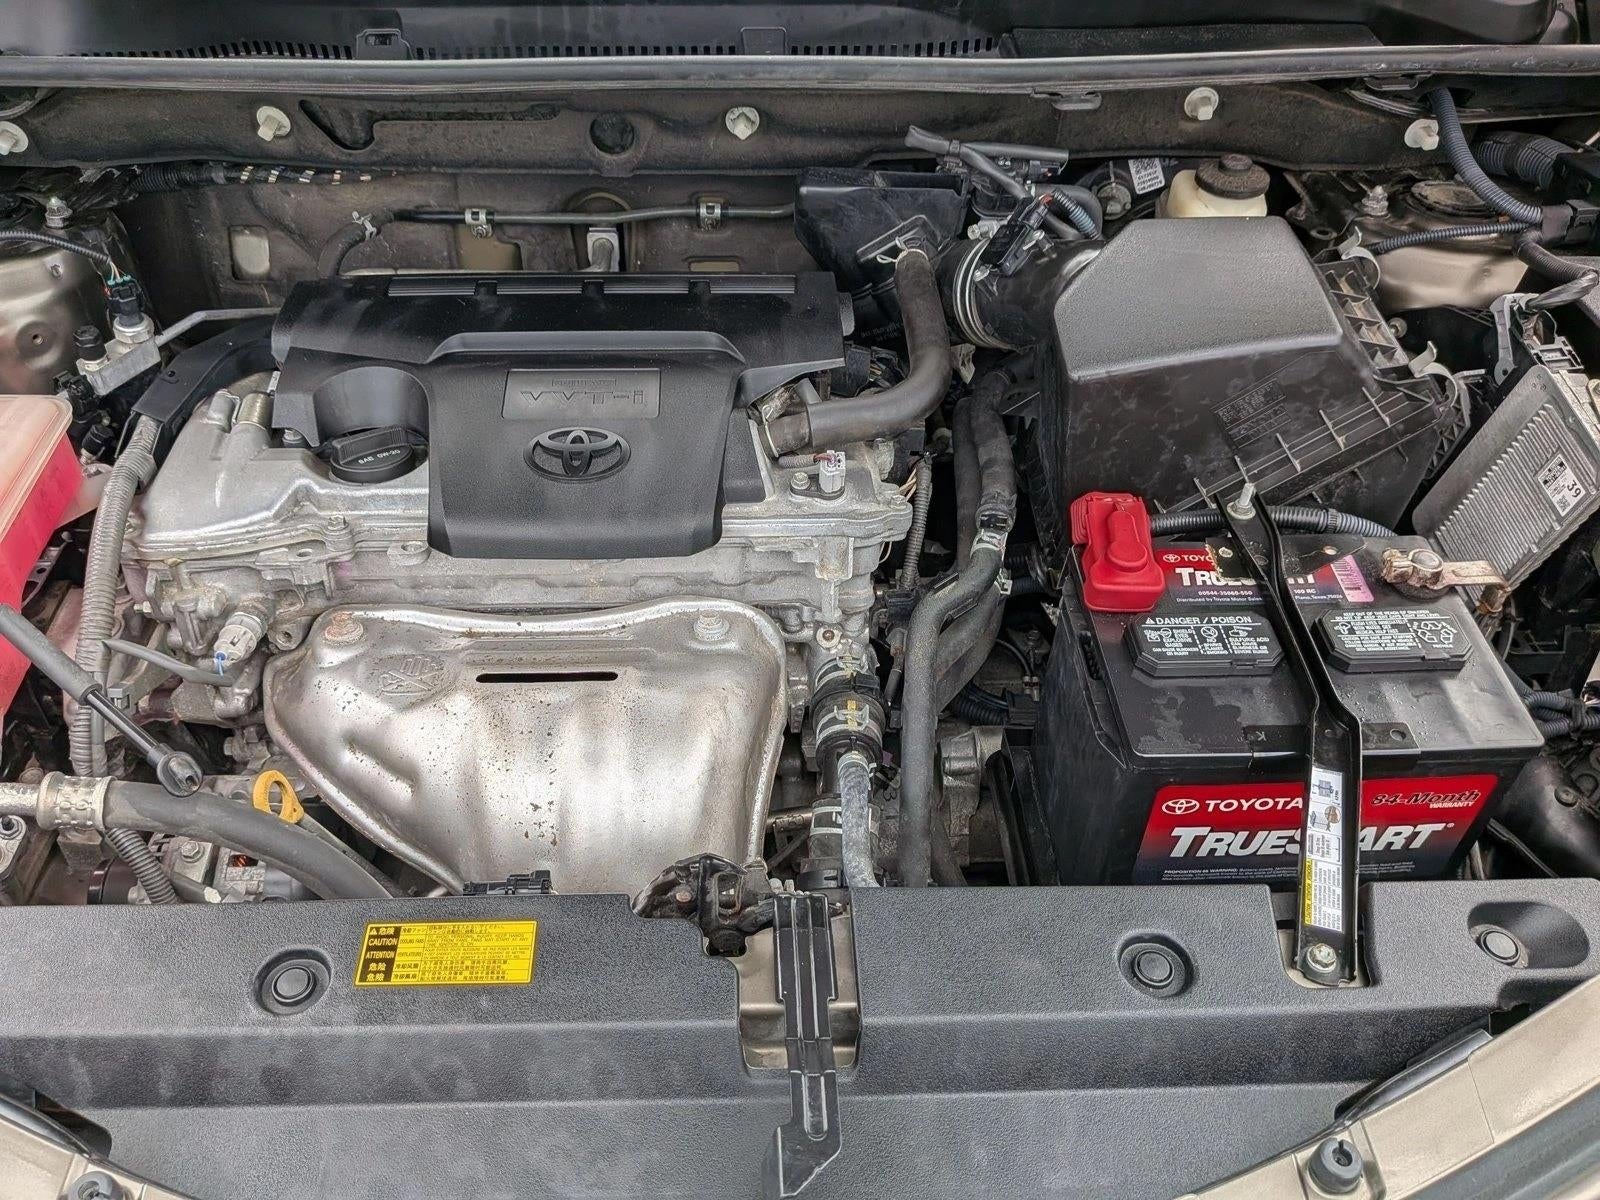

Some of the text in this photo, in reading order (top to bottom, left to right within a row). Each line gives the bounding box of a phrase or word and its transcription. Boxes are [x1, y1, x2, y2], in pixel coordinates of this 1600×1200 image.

[358, 456, 374, 465] SAE
[1567, 479, 1582, 498] 39
[1181, 555, 1215, 563] TOYO
[1155, 617, 1201, 625] DANGER
[1211, 616, 1253, 624] POISON
[1371, 790, 1481, 805] 84-Month
[1205, 797, 1303, 813] TOYOTA
[1429, 801, 1475, 809] WARRANTY
[368, 938, 398, 946] CAUTION
[365, 951, 396, 959] ATTENTION
